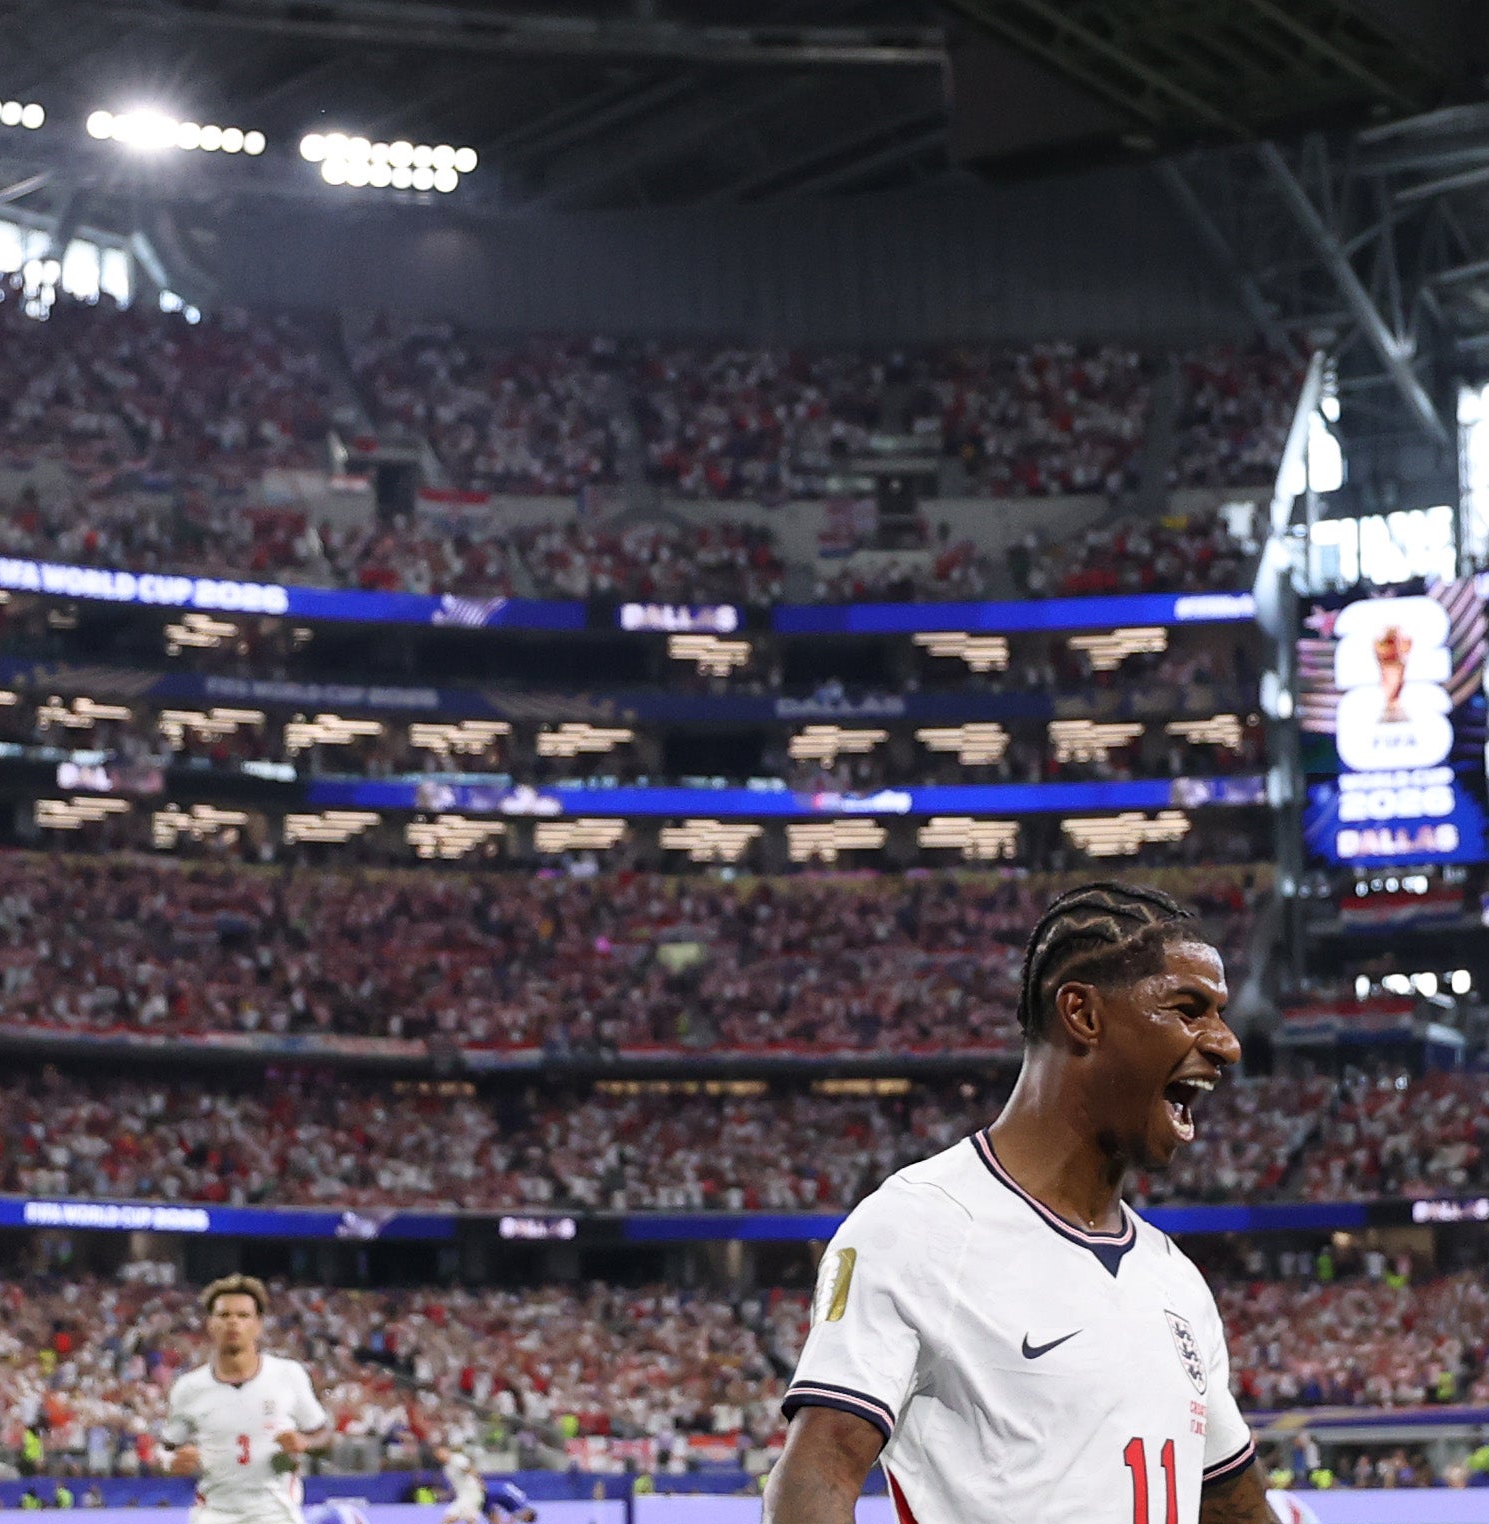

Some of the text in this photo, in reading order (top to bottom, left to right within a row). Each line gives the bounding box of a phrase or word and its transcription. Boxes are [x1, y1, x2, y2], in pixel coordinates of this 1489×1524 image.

[41, 563, 137, 601] WORLD
[138, 574, 192, 605] CUP
[193, 579, 288, 614] 2026
[621, 602, 738, 632] DALLAS
[1338, 766, 1455, 791] WORLD CUP
[1338, 785, 1456, 822] 2026
[1337, 823, 1459, 859] DALLAS
[237, 1433, 252, 1466] 3
